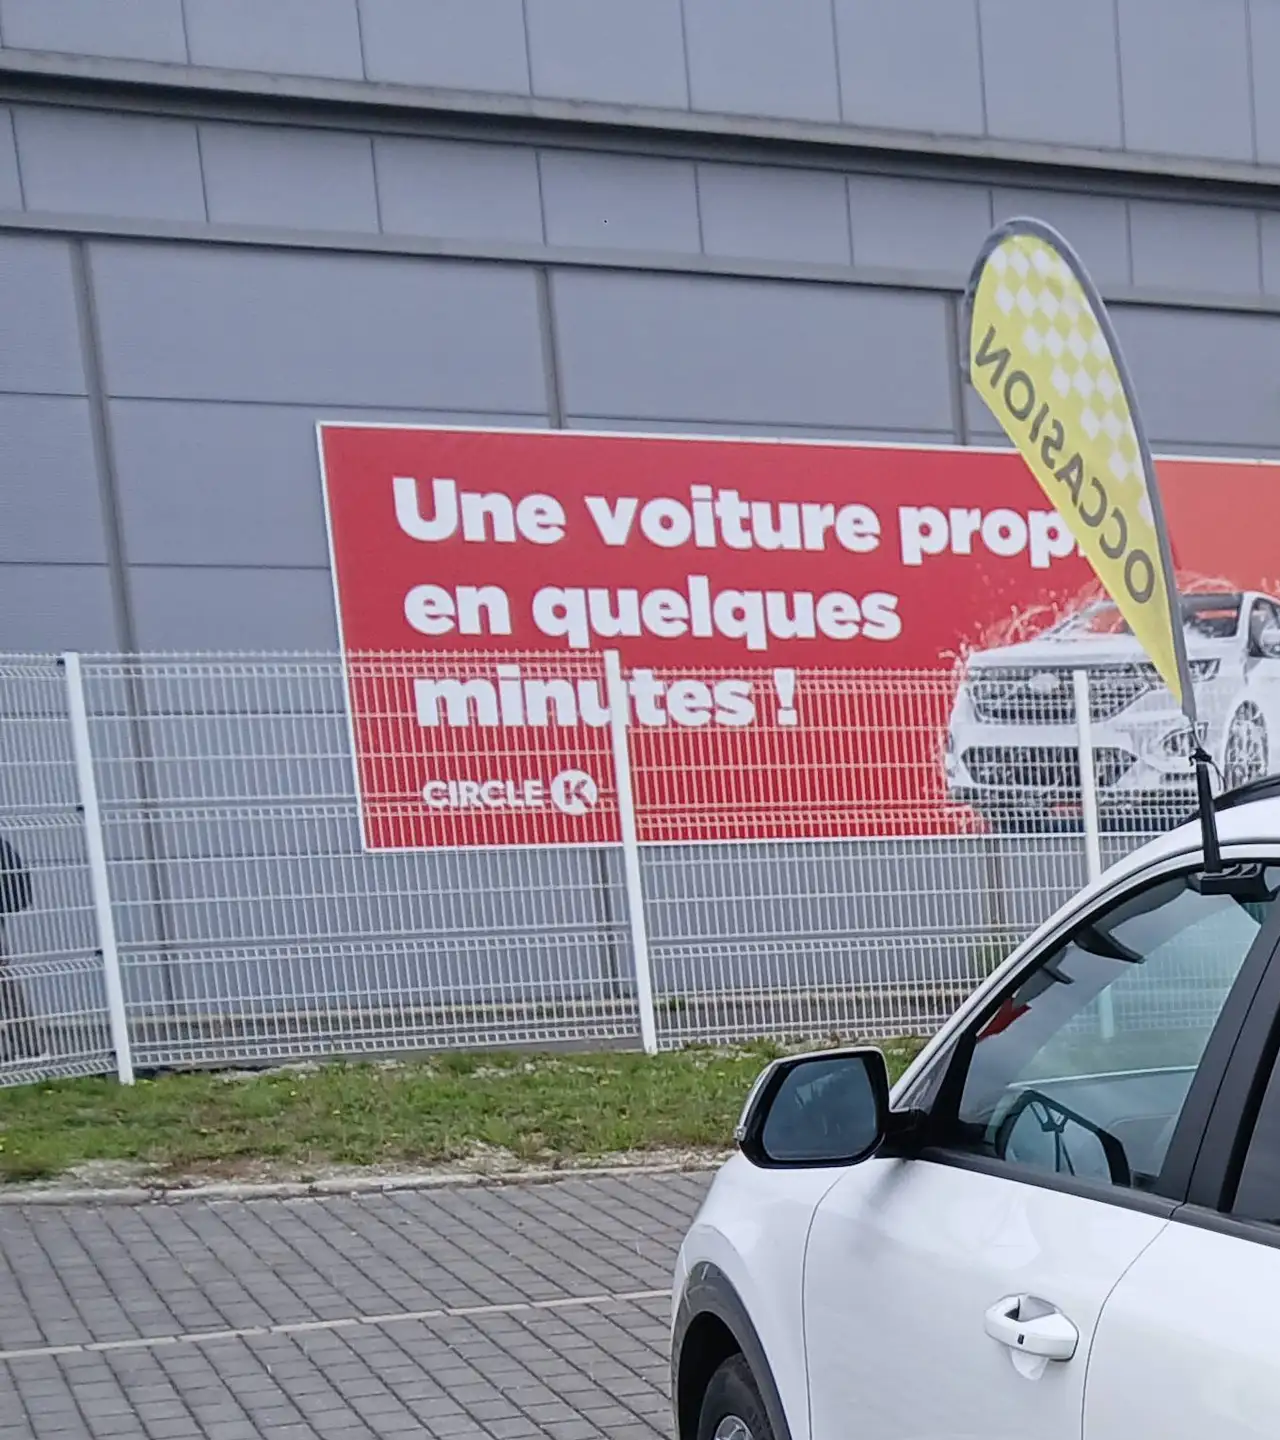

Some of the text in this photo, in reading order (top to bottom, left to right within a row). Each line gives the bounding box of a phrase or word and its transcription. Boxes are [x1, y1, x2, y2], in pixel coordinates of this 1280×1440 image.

[392, 476, 1088, 569] Une voiture prop
[403, 575, 902, 650] en quelques
[413, 664, 757, 727] minutes
[422, 779, 543, 811] CIRCLE
